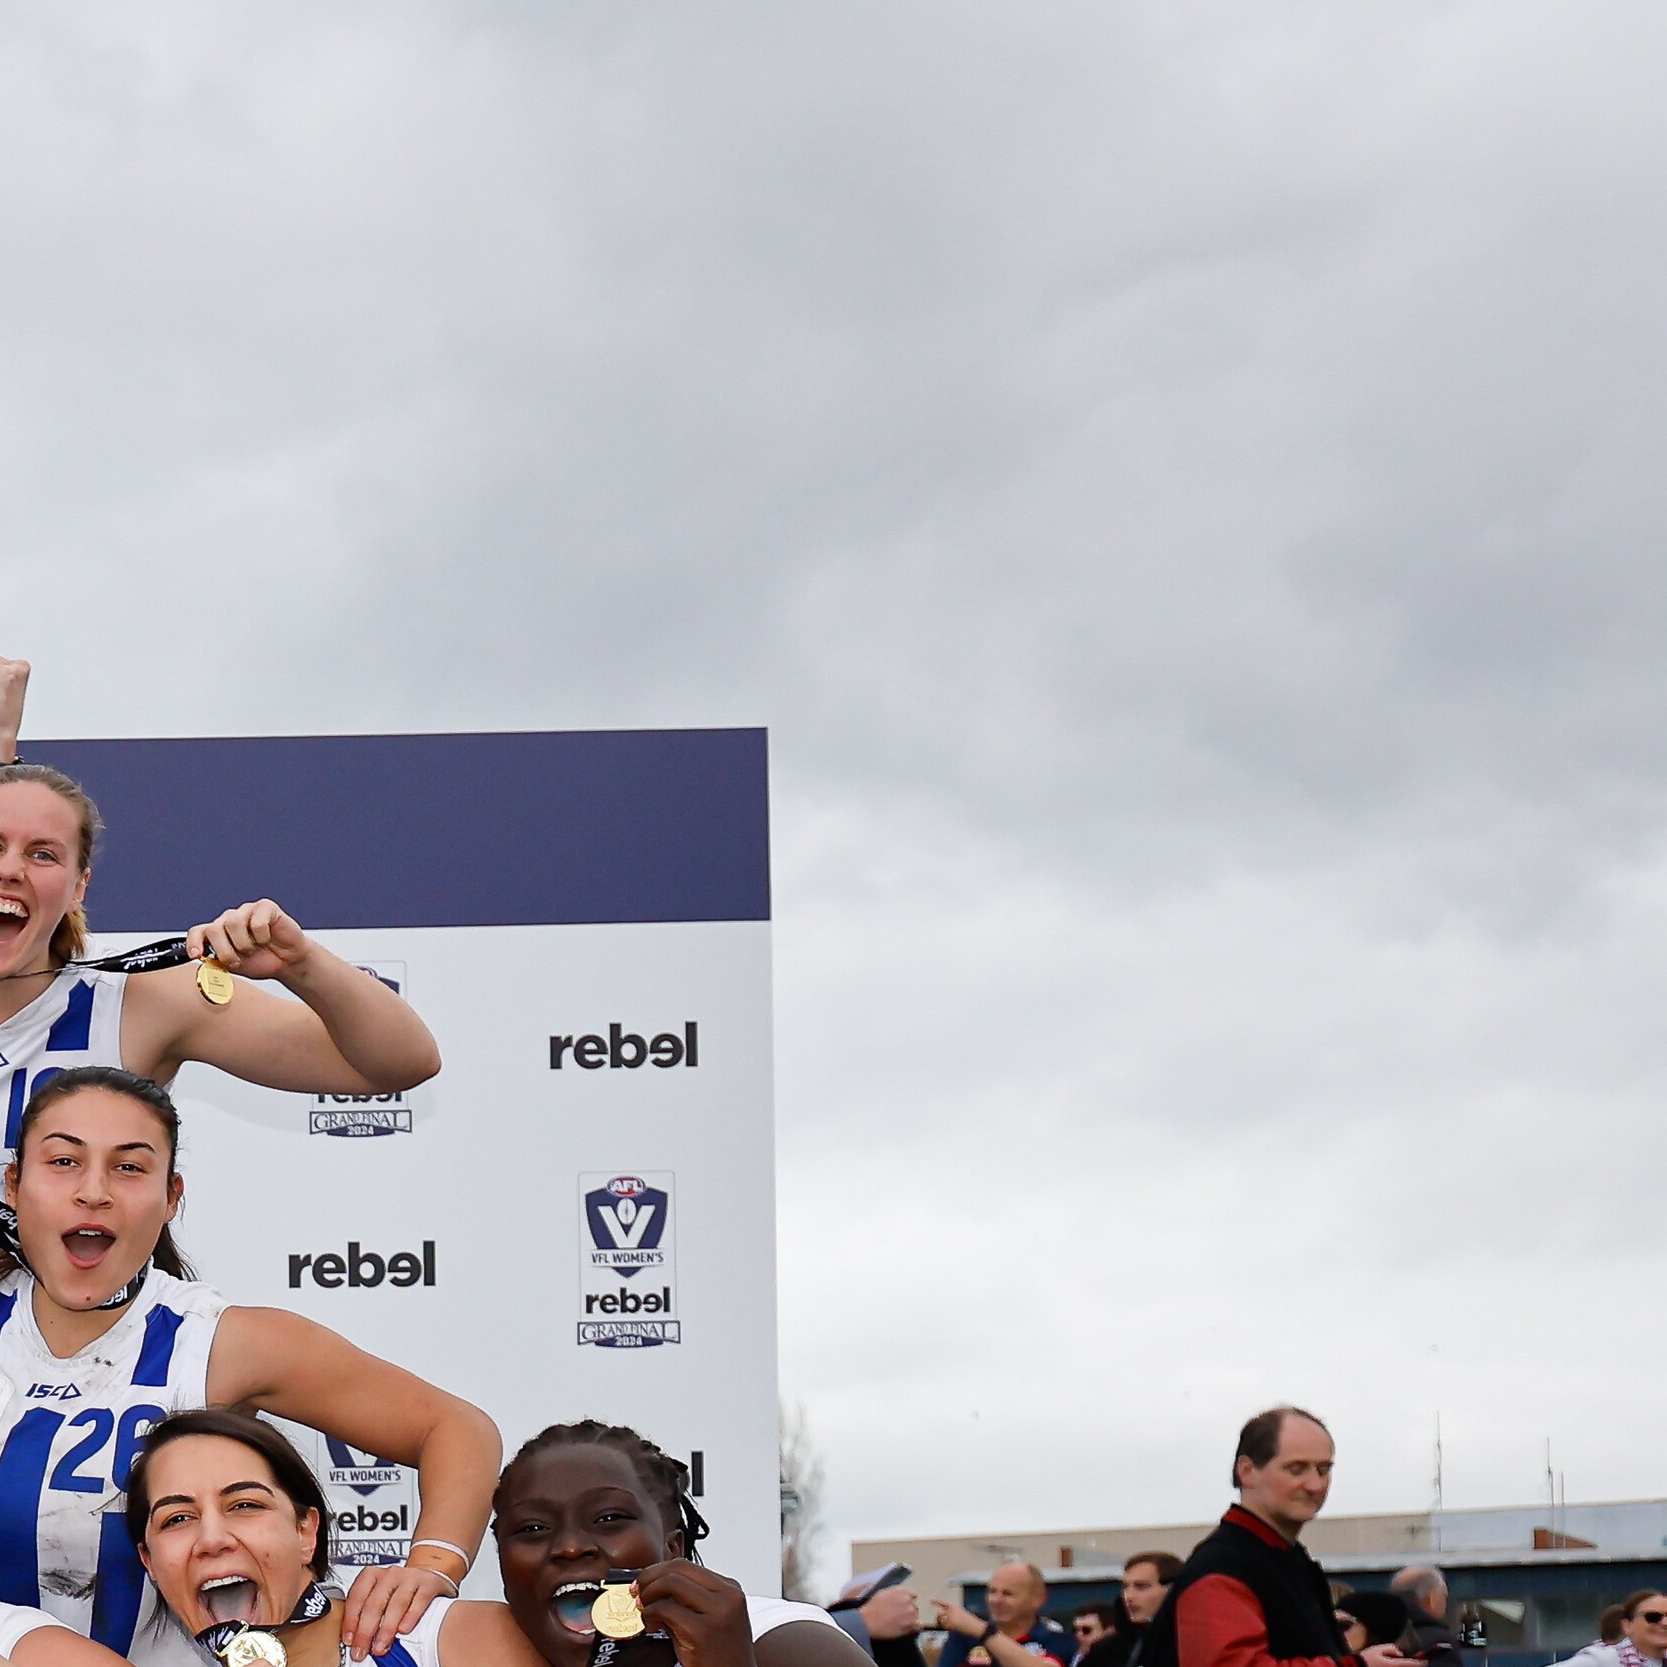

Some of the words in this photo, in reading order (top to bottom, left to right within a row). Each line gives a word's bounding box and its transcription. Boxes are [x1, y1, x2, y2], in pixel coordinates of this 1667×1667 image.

[550, 1022, 698, 1069] rebel
[610, 1179, 643, 1193] AFL
[288, 1241, 436, 1288] rebel
[591, 1253, 610, 1264] VFL
[586, 1287, 670, 1313] rebel
[26, 1383, 62, 1400] ISC
[329, 1471, 348, 1482] VFL
[350, 1470, 401, 1482] WOMEN'S
